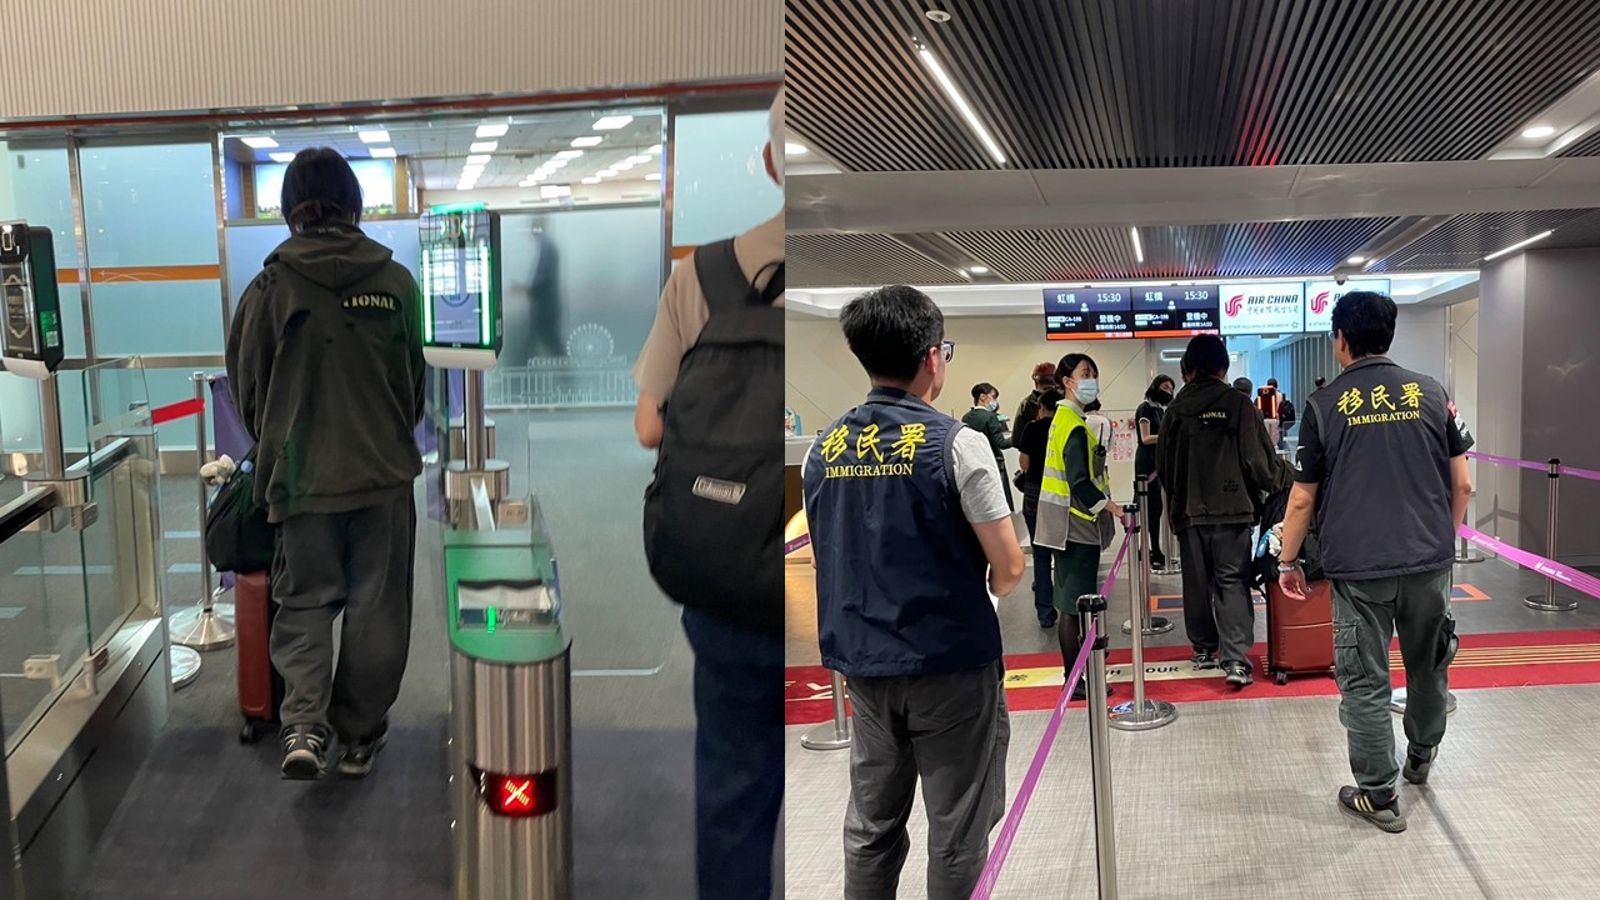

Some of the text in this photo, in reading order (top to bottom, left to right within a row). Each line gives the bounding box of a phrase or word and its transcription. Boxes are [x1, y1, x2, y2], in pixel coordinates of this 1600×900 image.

[1097, 292, 1122, 303] 15:30
[1184, 290, 1209, 301] 15:30
[1247, 294, 1299, 305] AIR CHINA
[1337, 382, 1424, 415] 移民署
[1198, 411, 1228, 419] IONAL
[1347, 410, 1421, 427] IMMIGRATION
[820, 423, 926, 463] 移民署
[825, 463, 914, 479] IMMIGRATION
[1144, 666, 1180, 674] OUR
